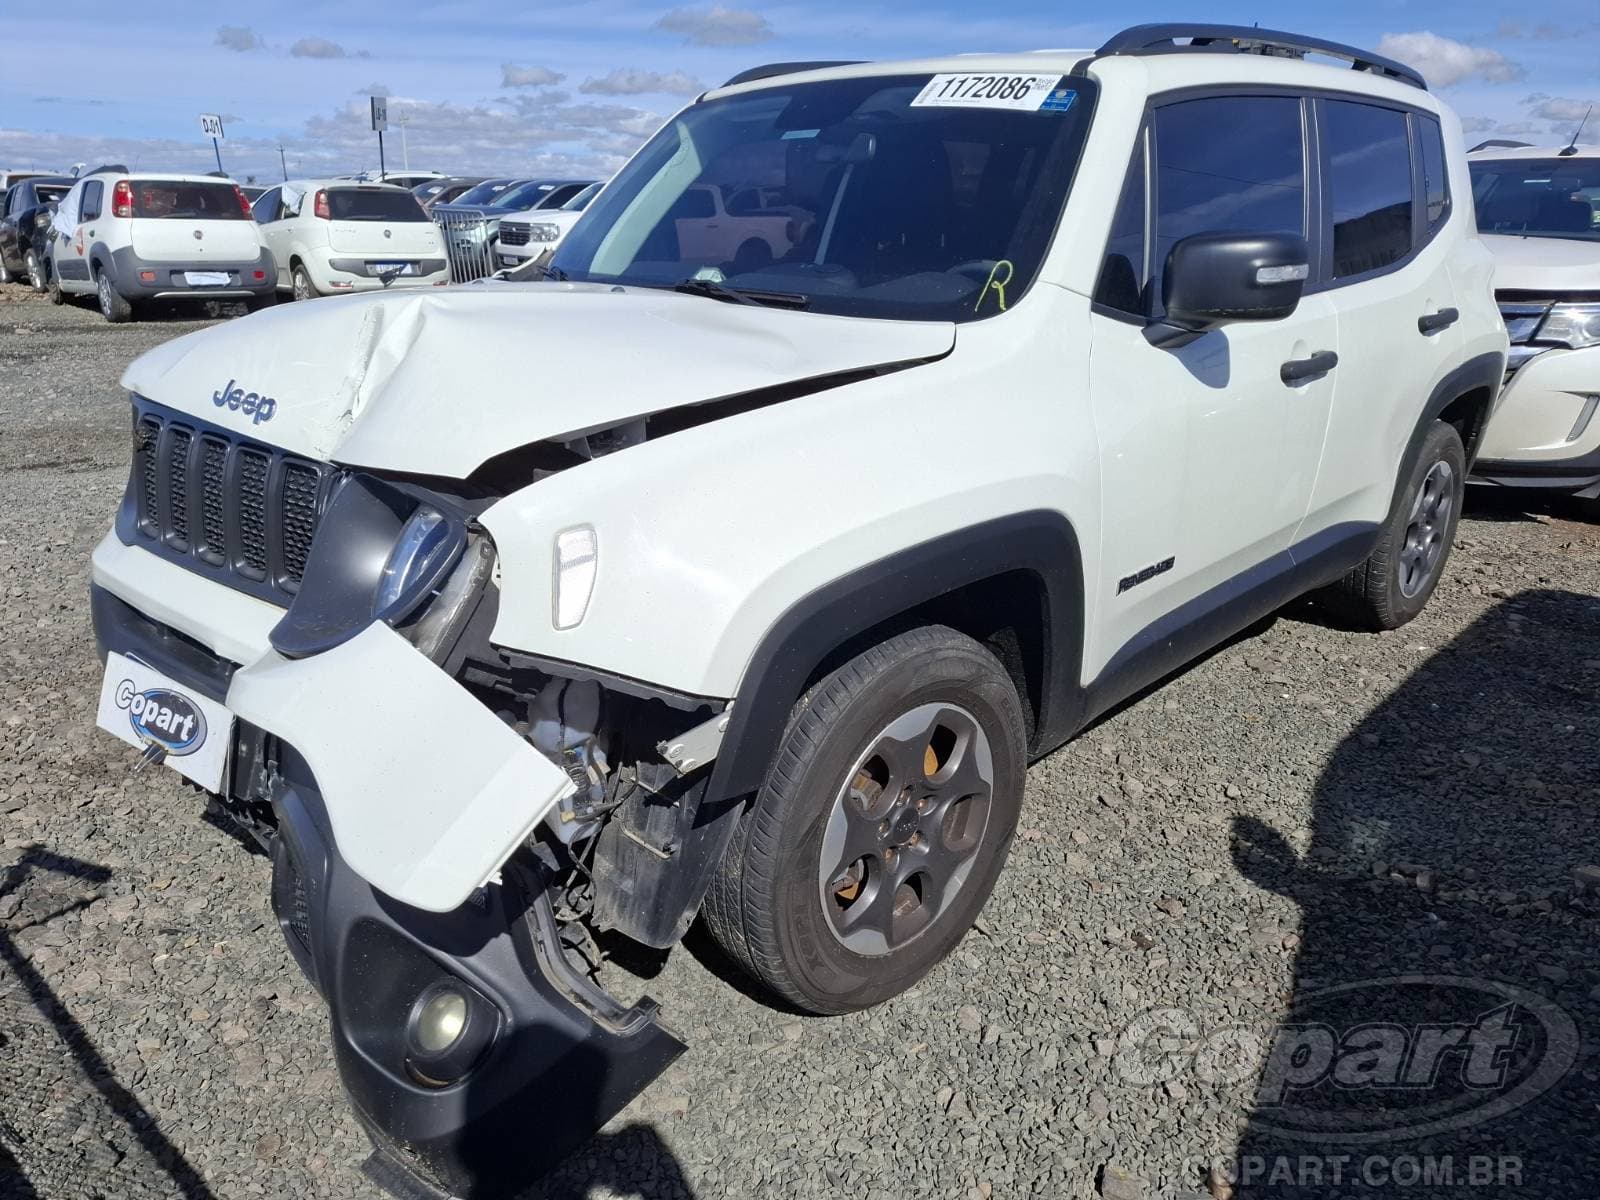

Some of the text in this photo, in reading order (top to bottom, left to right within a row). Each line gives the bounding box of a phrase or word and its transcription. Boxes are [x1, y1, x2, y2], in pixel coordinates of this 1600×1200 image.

[937, 76, 1036, 100] 1172086
[213, 379, 276, 425] Jeep
[115, 679, 194, 741] Copart
